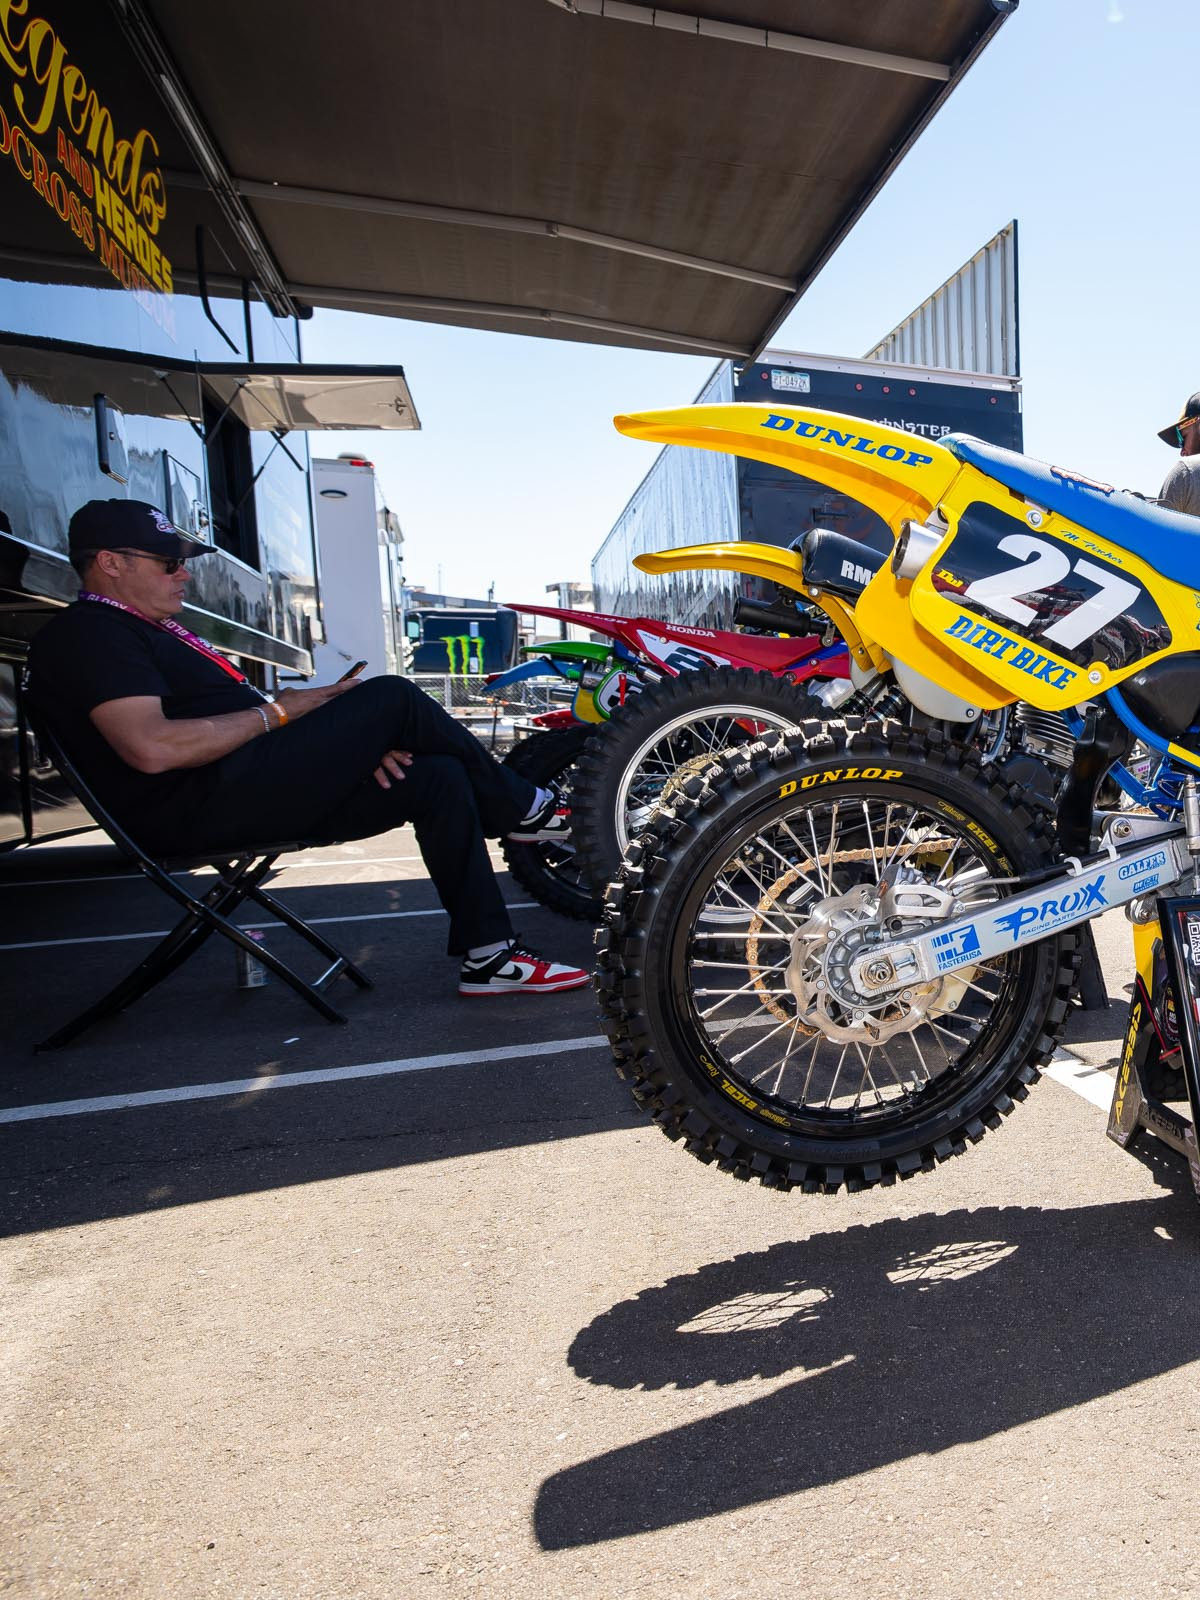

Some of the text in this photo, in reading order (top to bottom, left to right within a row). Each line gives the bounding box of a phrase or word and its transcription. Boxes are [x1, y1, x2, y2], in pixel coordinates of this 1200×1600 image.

[0, 0, 166, 236] egends
[57, 127, 173, 298] AND HEROES
[761, 414, 934, 468] DUNLOP
[873, 417, 952, 437] NSTER
[840, 560, 878, 586] RM
[964, 534, 1142, 650] 27
[159, 613, 190, 637] GLOR
[665, 623, 717, 638] HONDA
[944, 615, 1078, 691] DIRT BIKE
[778, 767, 904, 800] DUNLOP
[966, 822, 998, 853] EXCEL
[1020, 911, 1076, 938] RACING PARTS
[938, 950, 983, 972] FASTERUSA
[721, 1078, 758, 1112] EXCEL
